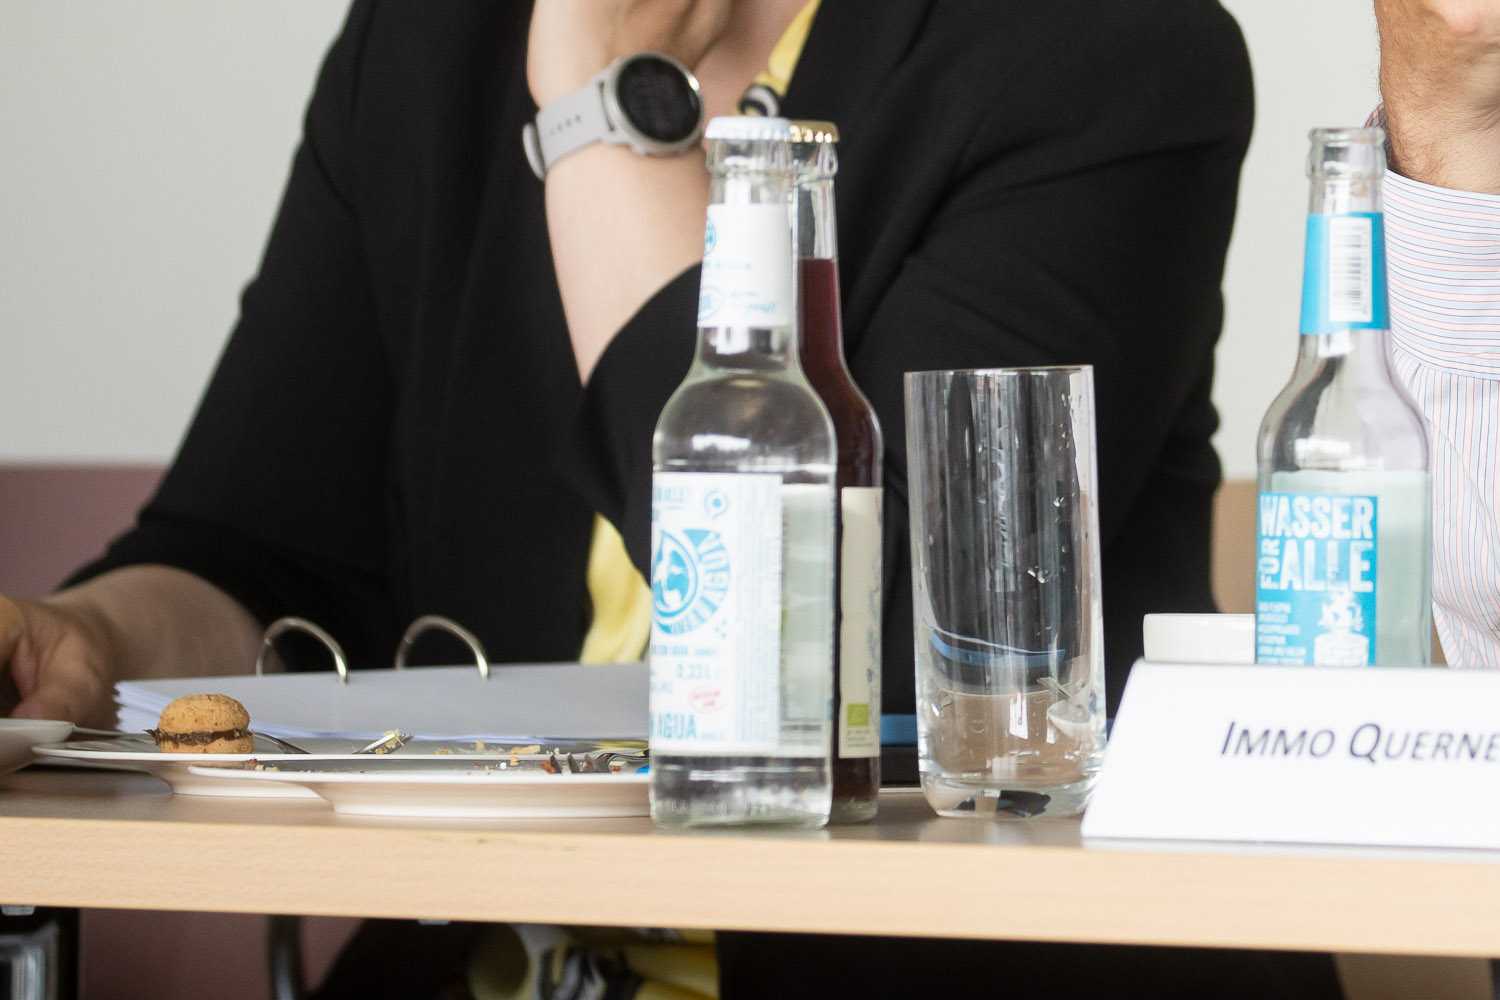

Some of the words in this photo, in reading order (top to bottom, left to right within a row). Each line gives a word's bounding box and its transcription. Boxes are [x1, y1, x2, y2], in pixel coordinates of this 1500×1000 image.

[1260, 495, 1374, 539] WASSER
[1280, 539, 1374, 593] ALLE
[1220, 720, 1336, 758] IMMO
